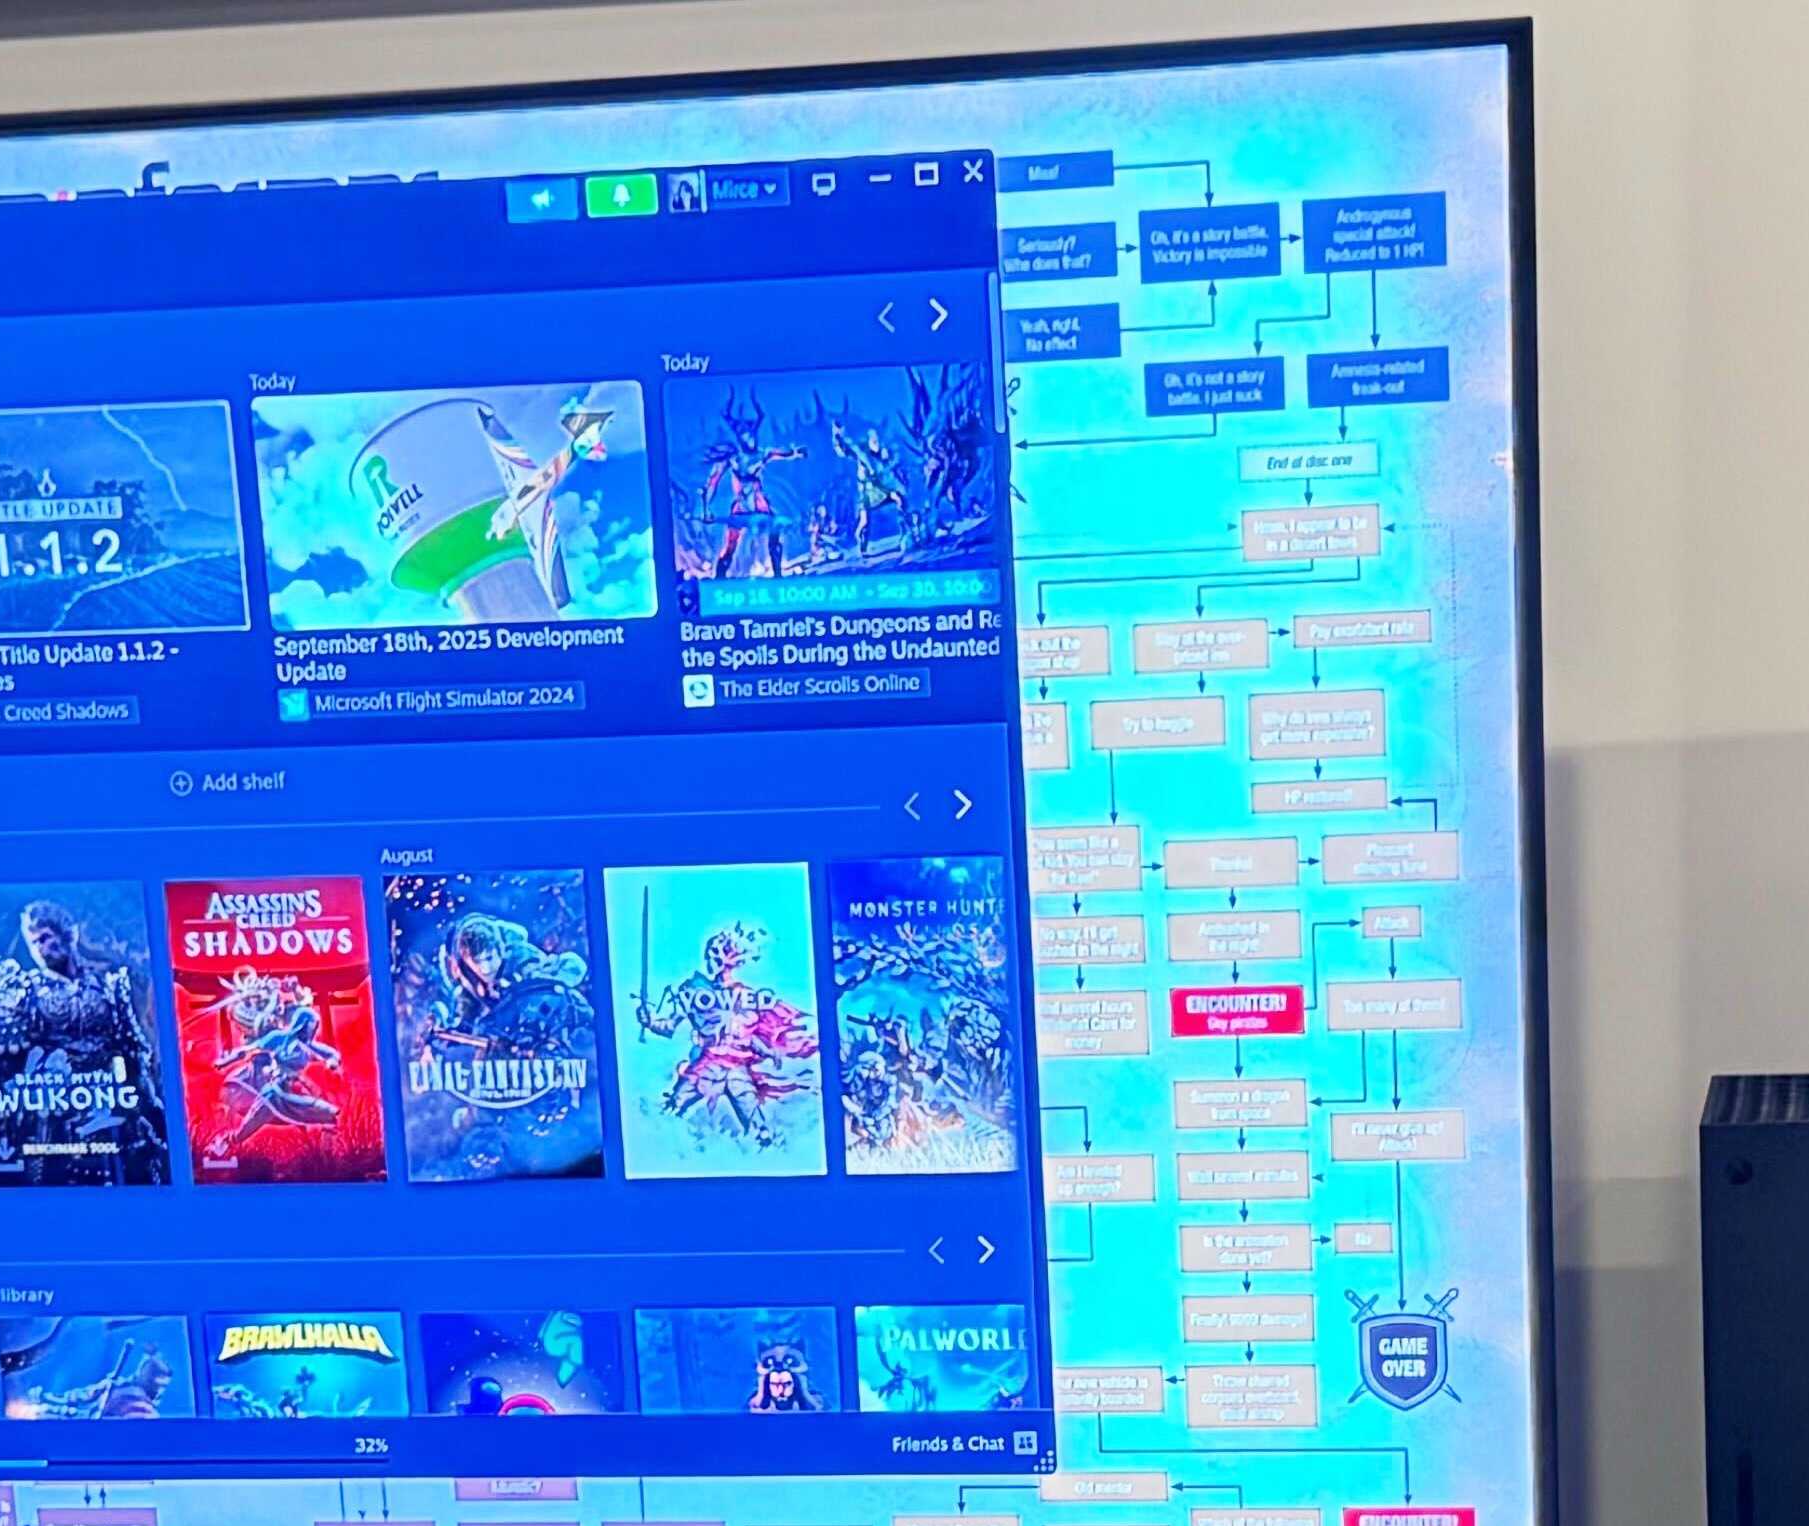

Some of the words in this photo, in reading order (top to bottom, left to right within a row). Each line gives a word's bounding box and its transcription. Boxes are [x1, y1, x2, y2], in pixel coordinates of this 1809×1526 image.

[662, 354, 710, 373] Today
[249, 373, 296, 391] Today
[44, 500, 117, 516] UPDATE
[274, 635, 377, 659] September
[383, 635, 432, 653] 18th,
[439, 632, 492, 650] 2025
[497, 626, 624, 648] Development
[681, 648, 715, 668] the
[720, 646, 778, 668] Spoils
[783, 643, 848, 666] During
[853, 641, 887, 662] the
[892, 637, 1000, 659] Undaunted
[276, 664, 347, 684] Update
[720, 679, 753, 698] The
[758, 678, 801, 697] Elder
[806, 677, 861, 695] Scrolls
[865, 674, 920, 693] Online
[315, 692, 392, 713] Microsoft
[397, 691, 442, 710] Flight
[446, 689, 525, 707] Simulator
[530, 688, 575, 704] 2024
[202, 774, 237, 792] Add
[243, 771, 285, 790] shelf
[380, 848, 434, 865] August
[184, 928, 353, 957] SHADOWS
[1, 1287, 54, 1306] library
[1378, 1337, 1428, 1356] GAME
[1382, 1359, 1426, 1378] OVER
